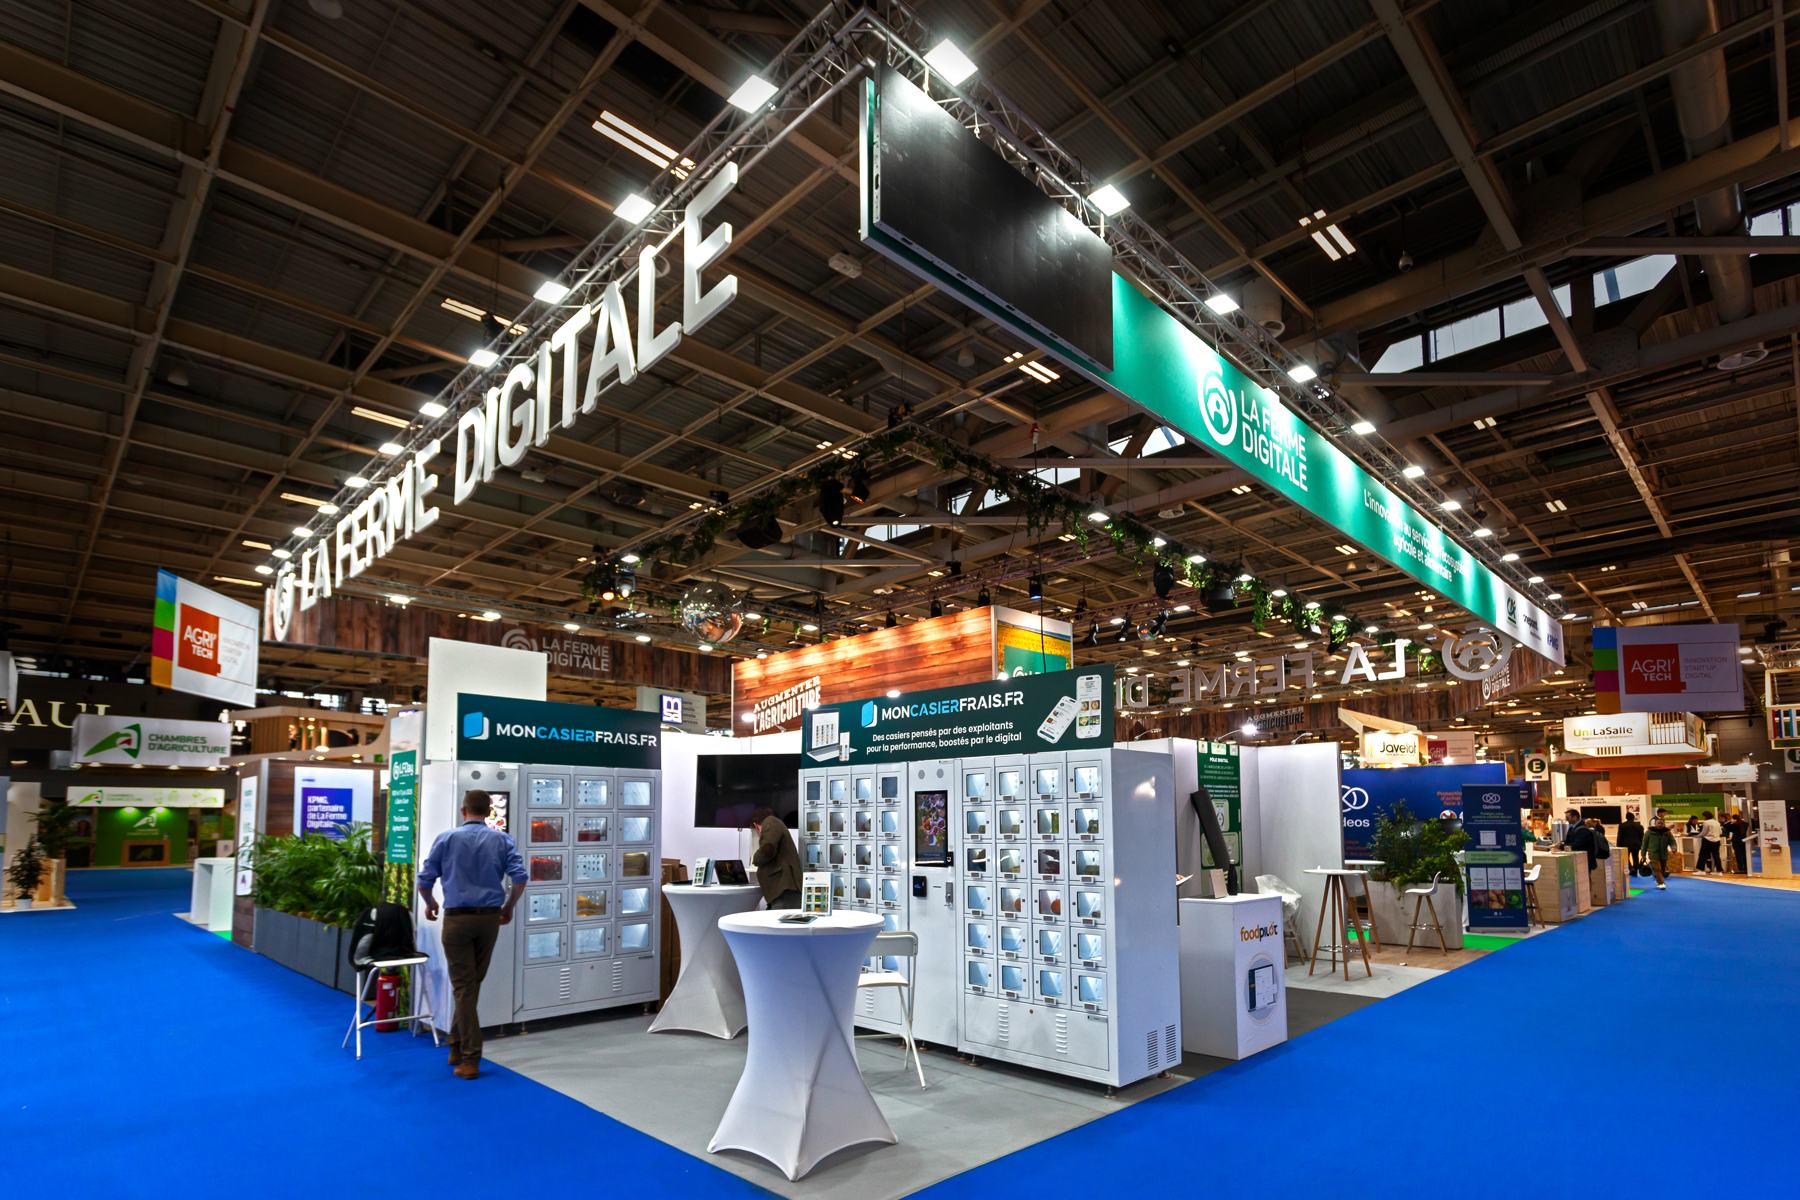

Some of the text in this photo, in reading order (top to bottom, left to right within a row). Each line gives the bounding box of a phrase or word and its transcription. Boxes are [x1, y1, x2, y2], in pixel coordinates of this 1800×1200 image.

[301, 161, 738, 612] LA FERME DIGITALE
[1241, 390, 1261, 429] LA
[1242, 421, 1308, 493] DIGITALE
[1364, 488, 1403, 531] L'innova
[183, 625, 217, 649] AGRI'
[542, 637, 610, 658] LA FERME
[191, 644, 214, 660] TECH
[547, 651, 610, 672] DIGITALE
[1631, 658, 1675, 673] AGRI'
[1642, 673, 1672, 681] TECH
[753, 675, 821, 713] AUGMENTER
[753, 685, 821, 734] L'AGRICULTURE
[881, 690, 1024, 721] MONCASIERFRAIS.FR
[148, 733, 207, 744] CHAMBRES
[496, 723, 657, 747] MONCASIERFRAIS.FR
[872, 721, 1014, 742] Des casiers pensés par des exploitants
[1573, 726, 1633, 737] UniLaSalle
[147, 743, 227, 754] D'AGRICULTURE
[866, 731, 1022, 755] pour la performance, boostés par le digital
[1533, 761, 1542, 772] E
[307, 805, 344, 813] partenaire
[307, 812, 317, 820] de
[325, 812, 347, 820] Ferme
[1240, 921, 1278, 942] foodpilot
